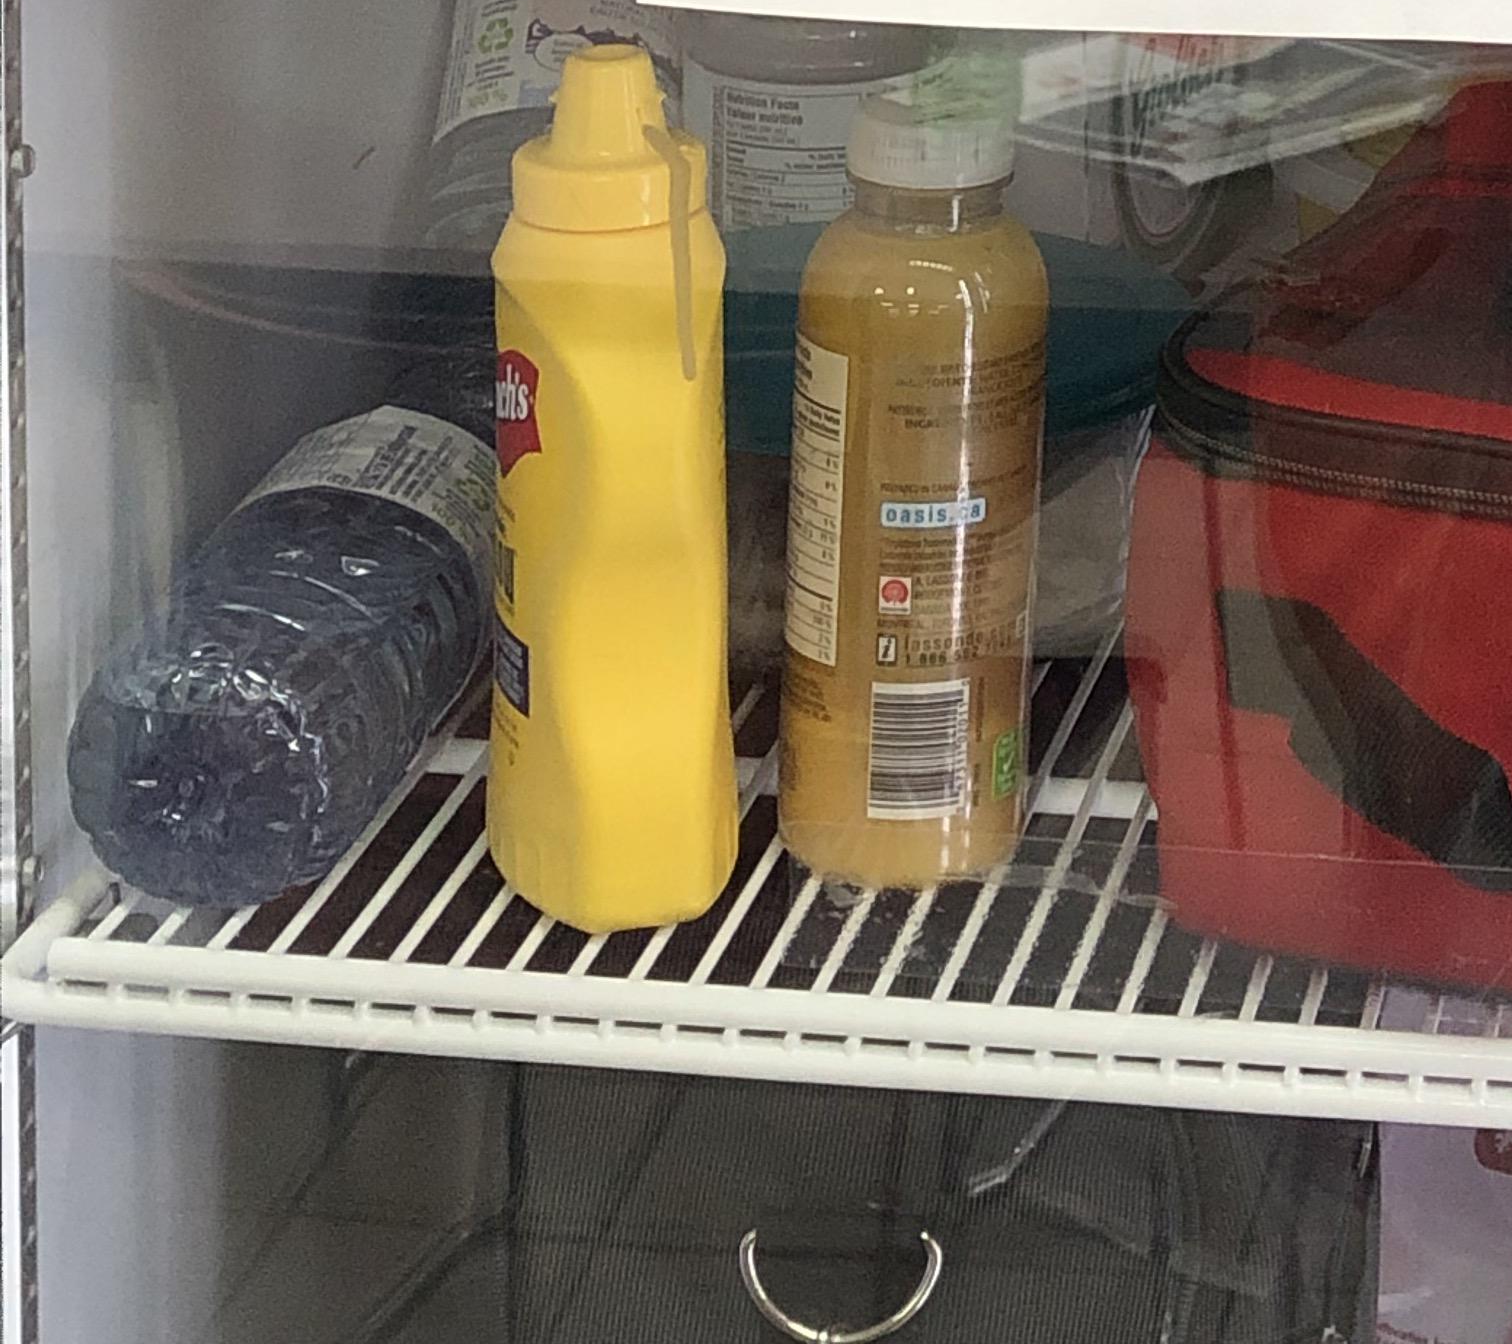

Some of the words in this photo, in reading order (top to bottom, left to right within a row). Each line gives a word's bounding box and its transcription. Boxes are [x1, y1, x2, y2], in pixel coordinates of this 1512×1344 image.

[727, 92, 768, 108] Nutrition
[770, 98, 800, 110] Facts
[495, 363, 529, 421] ch's
